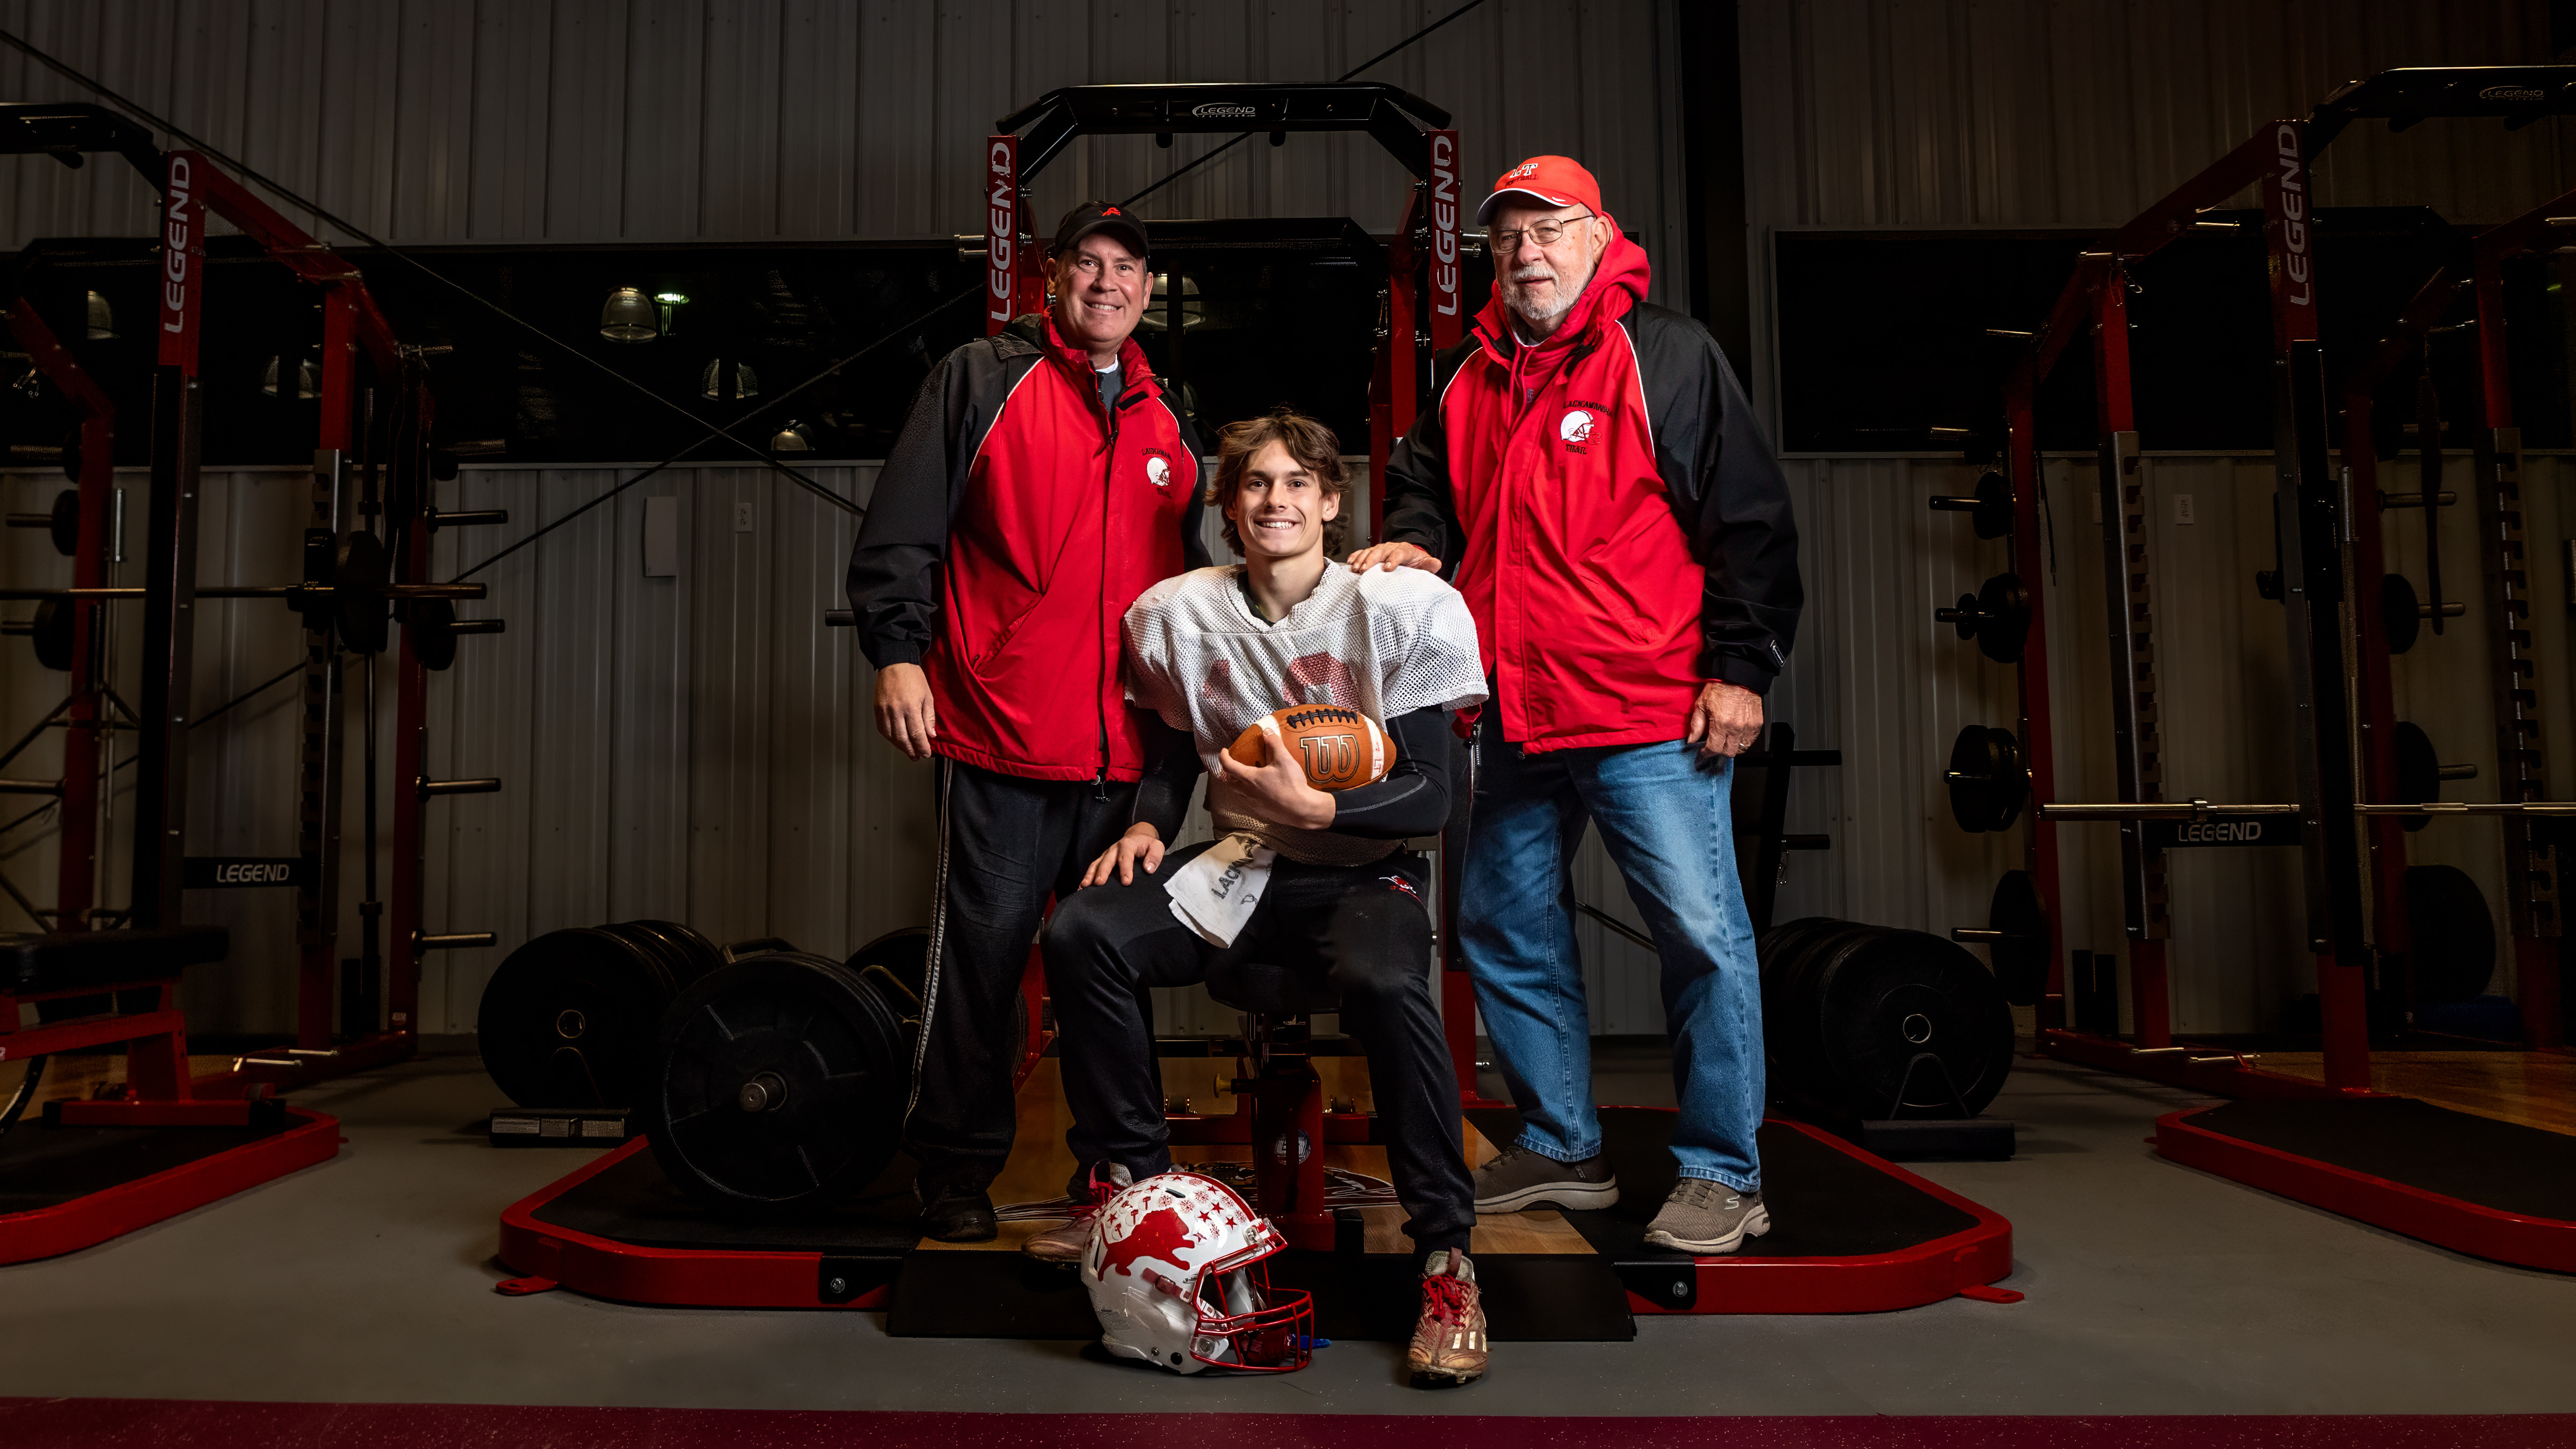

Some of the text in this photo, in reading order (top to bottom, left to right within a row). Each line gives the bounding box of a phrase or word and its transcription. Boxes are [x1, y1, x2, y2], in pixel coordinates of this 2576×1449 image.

[164, 157, 189, 334] LEGEND
[991, 142, 1011, 322] LEGEND
[1434, 136, 1457, 316] LEGEND
[1509, 163, 1538, 178] LT
[2278, 125, 2309, 305] LEGEND
[216, 863, 290, 883] LEGEND
[2178, 822, 2262, 841] LEGEND
